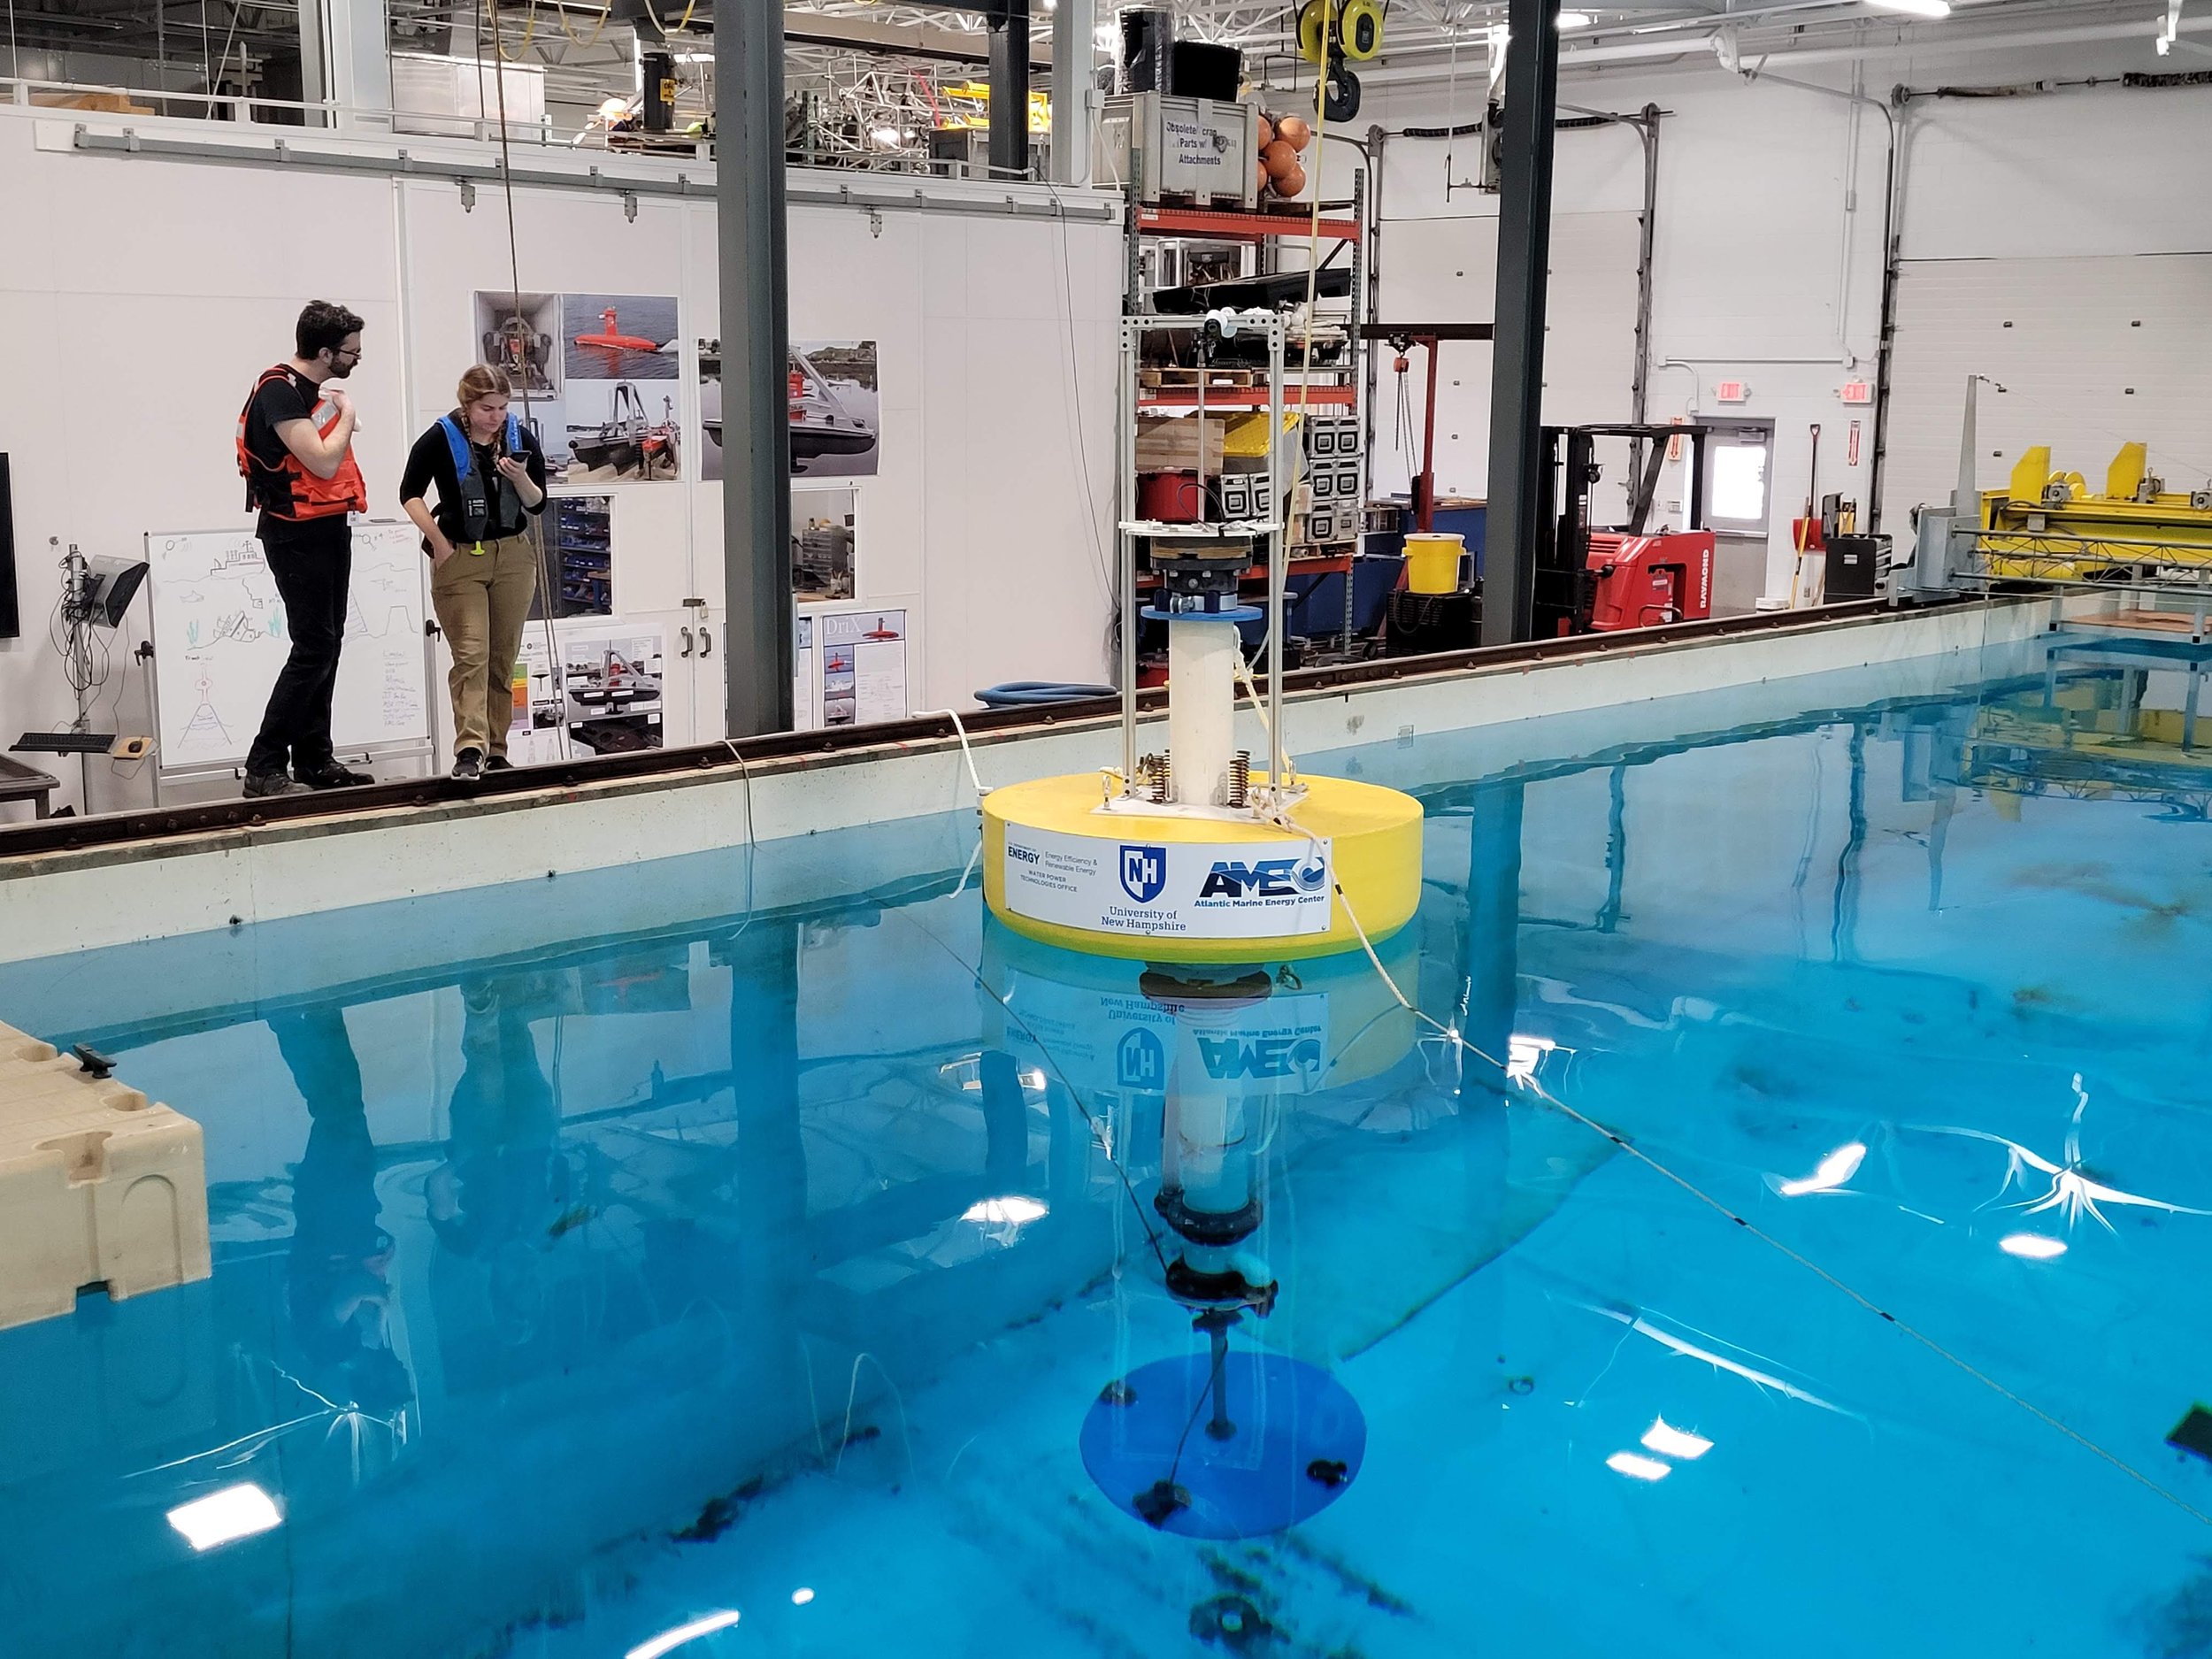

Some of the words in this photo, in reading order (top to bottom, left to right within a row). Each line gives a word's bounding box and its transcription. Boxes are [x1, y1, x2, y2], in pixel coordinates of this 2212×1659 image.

[1180, 138, 1197, 148] Parts
[1179, 154, 1221, 165] Attachments
[1700, 549, 1709, 609] RAYMOND
[826, 617, 862, 634] DriX
[1008, 846, 1040, 864] ENERGY
[1045, 851, 1063, 862] Energy
[1064, 855, 1091, 866] Efficiency
[1028, 870, 1045, 879] WATER
[1045, 860, 1075, 872] Renewable
[1075, 865, 1096, 876] Energy
[1129, 857, 1157, 884] NH
[1020, 874, 1056, 888] TECHNOLOGIES
[1057, 883, 1078, 893] OFFICE
[1199, 856, 1325, 898] AMEC
[1110, 906, 1164, 920] University
[1166, 910, 1178, 919] of
[1102, 916, 1125, 927] New
[1126, 918, 1187, 931] Hampshire
